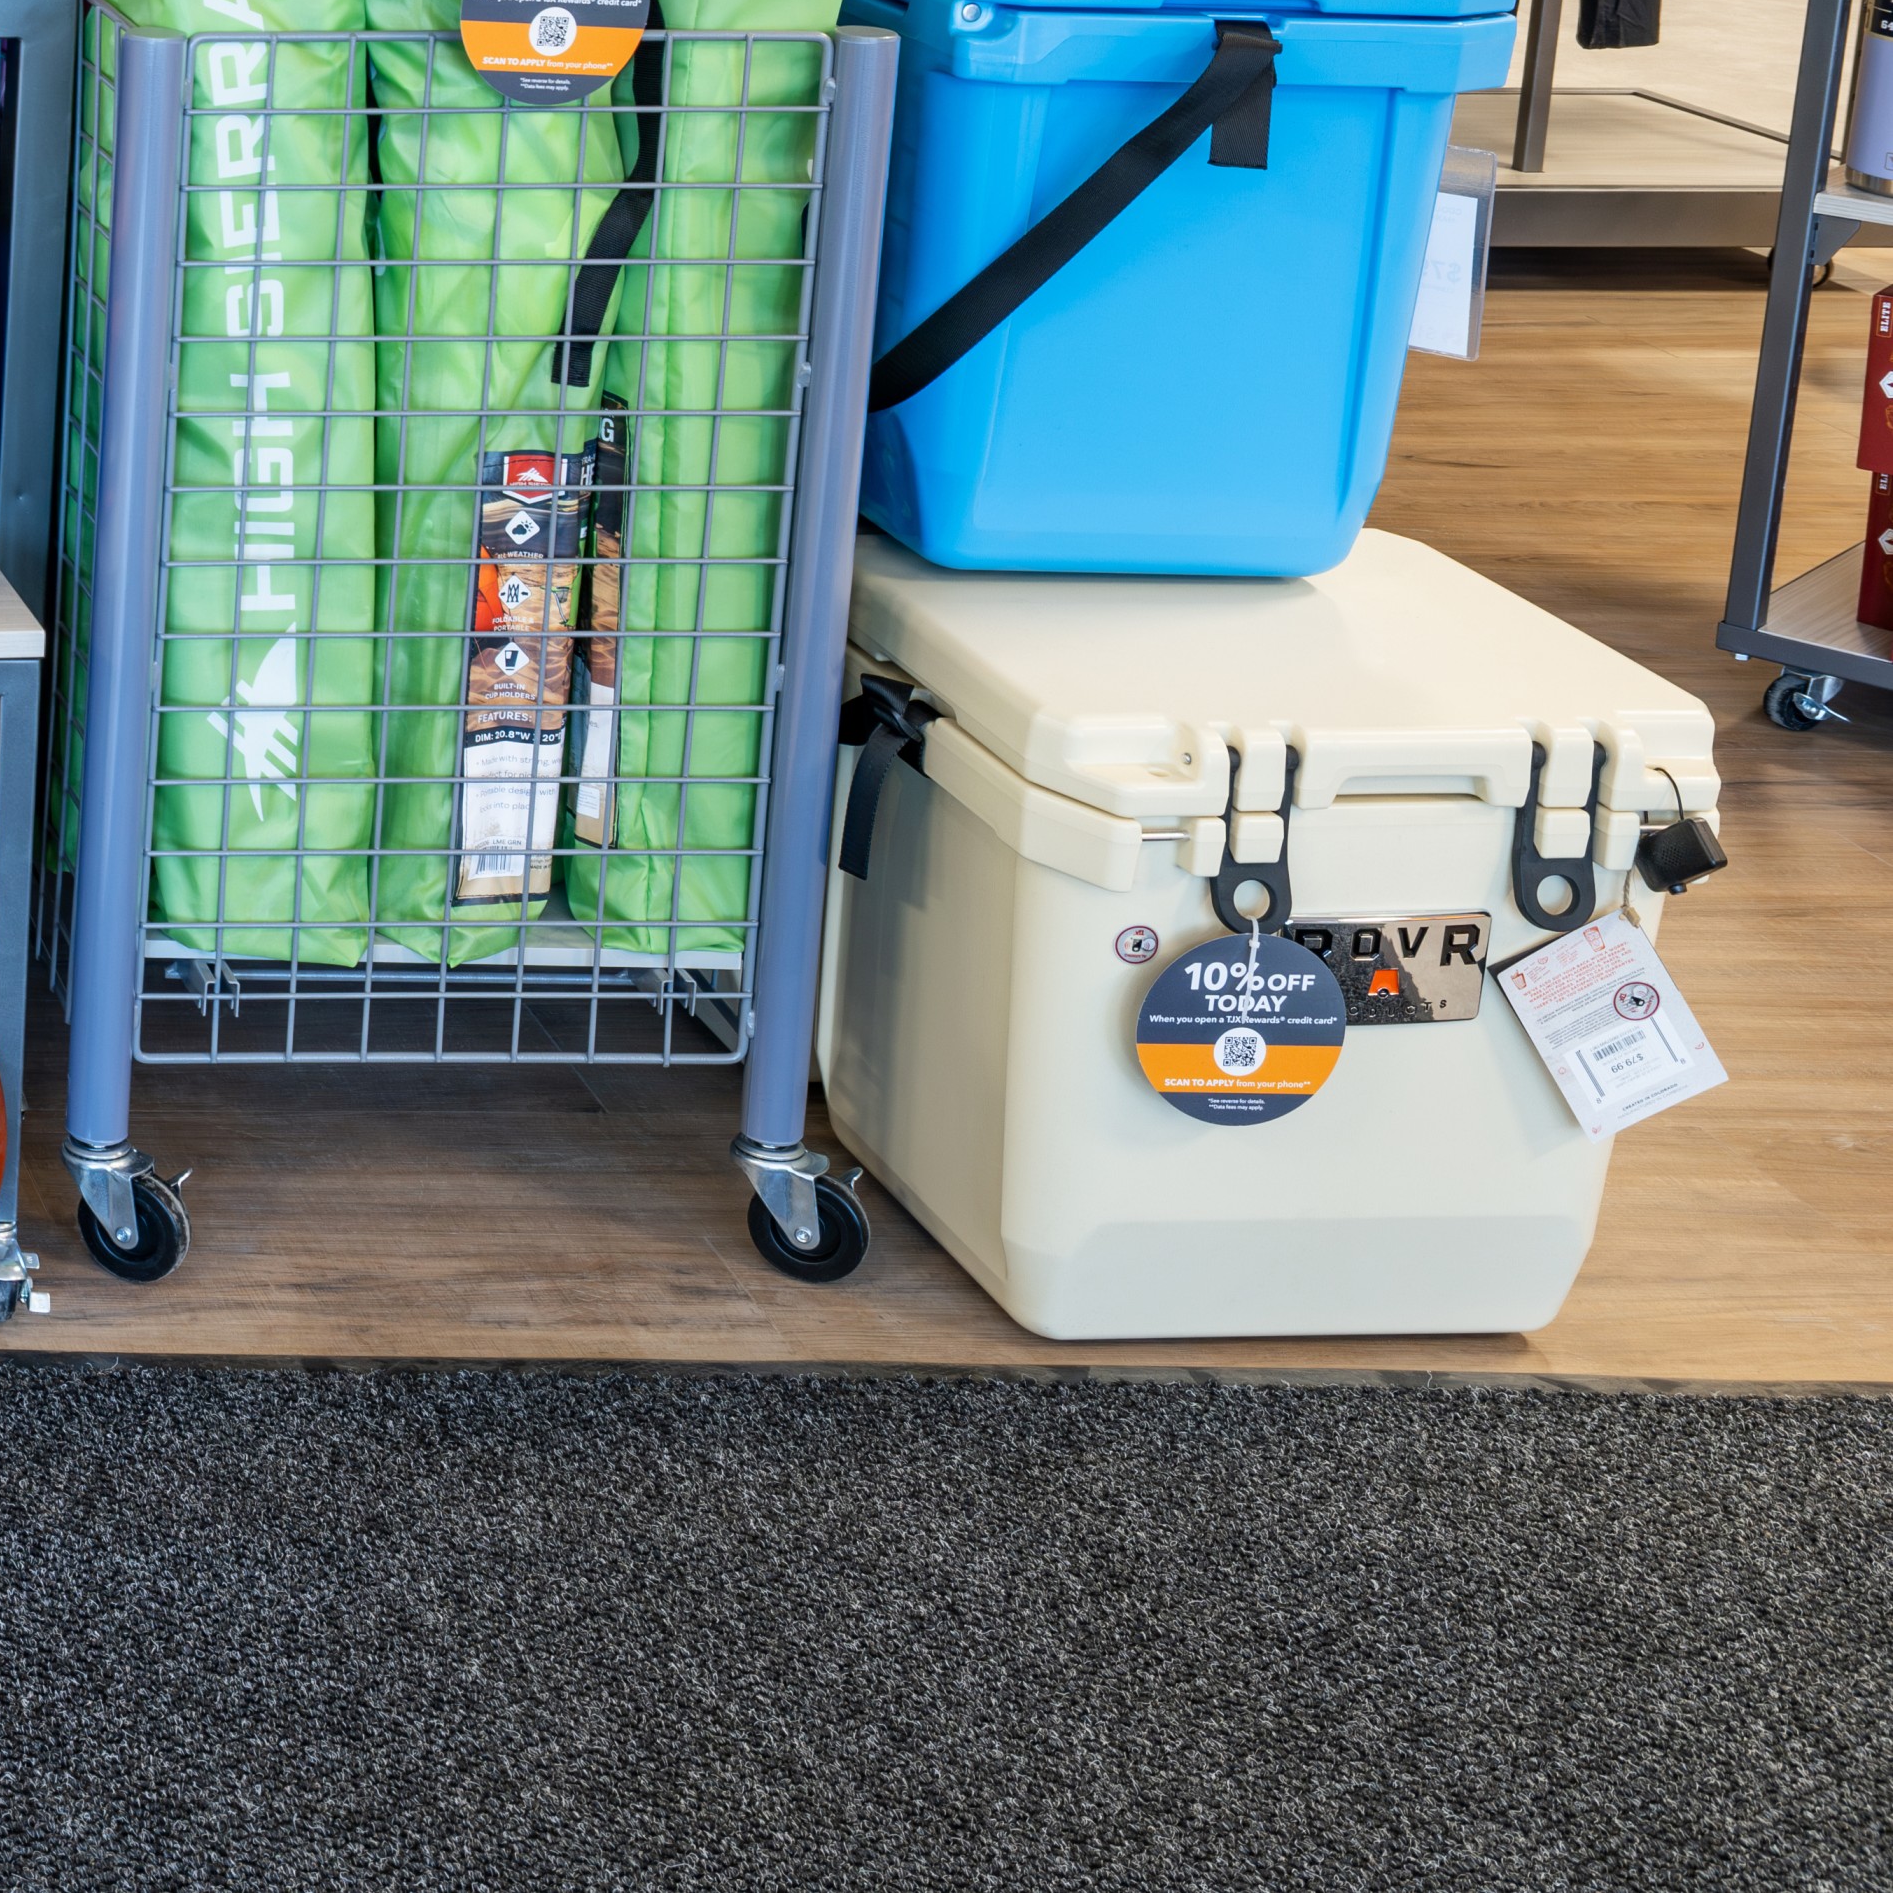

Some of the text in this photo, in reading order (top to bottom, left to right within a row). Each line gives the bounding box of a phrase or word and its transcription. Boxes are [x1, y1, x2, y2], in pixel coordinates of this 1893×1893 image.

[230, 370, 298, 611] HIGH
[1184, 962, 1315, 992] 10% OFF
[1205, 995, 1287, 1012] TODAY
[1165, 1079, 1190, 1087] SCAN
[1192, 1079, 1204, 1087] TO
[1206, 1079, 1234, 1088] APPLY
[1257, 1081, 1275, 1089] your
